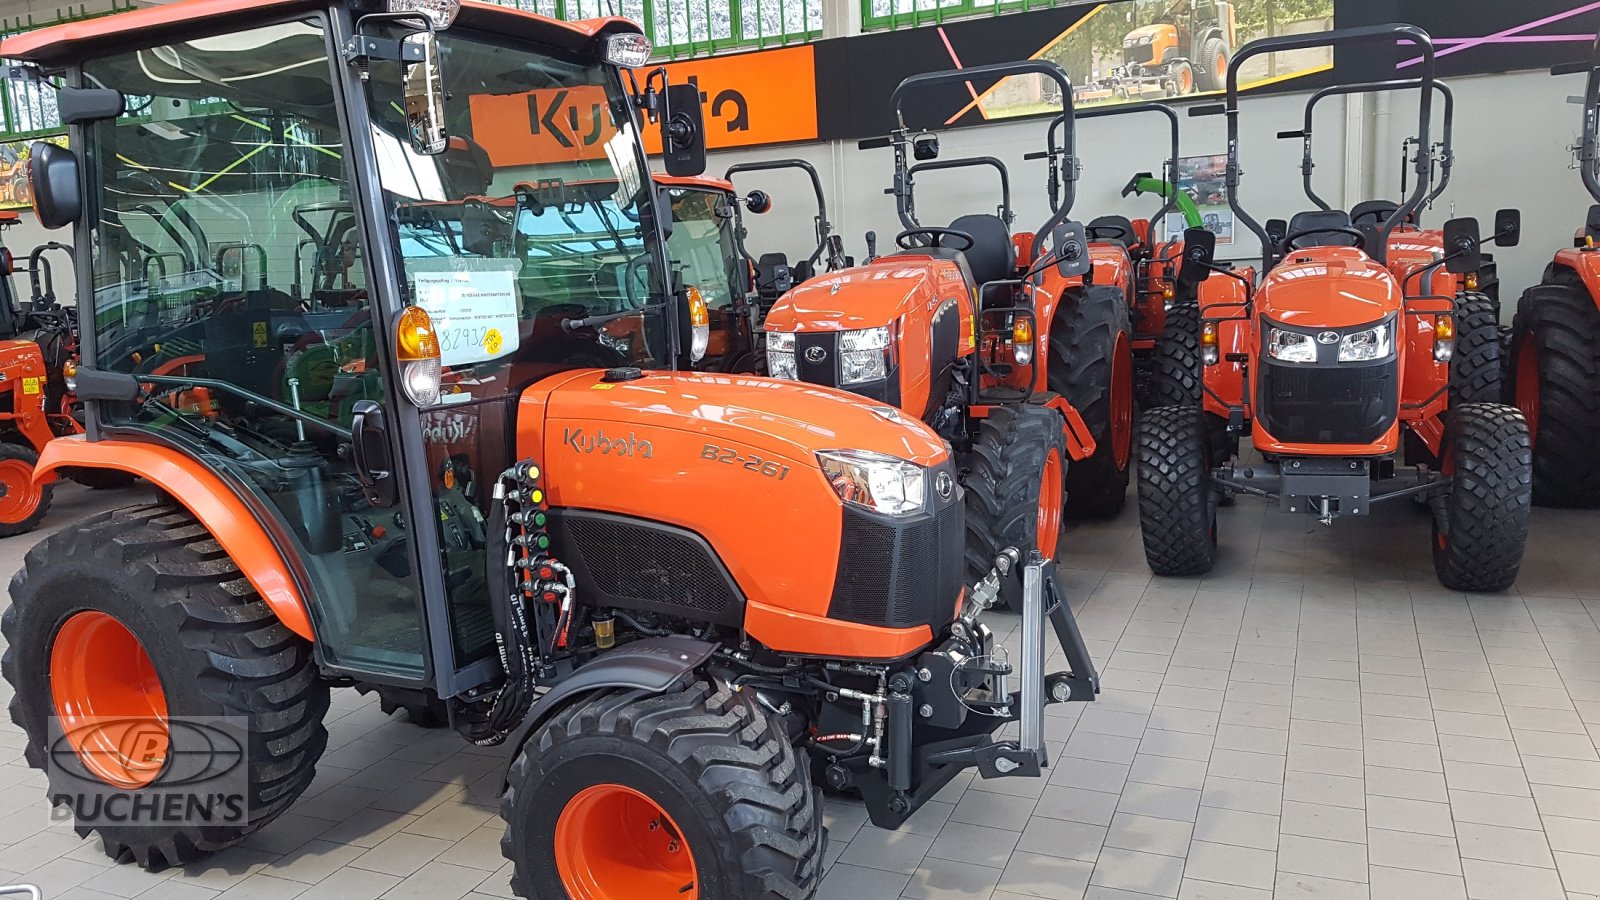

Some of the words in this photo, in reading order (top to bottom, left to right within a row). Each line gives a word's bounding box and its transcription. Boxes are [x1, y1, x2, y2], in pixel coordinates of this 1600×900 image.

[441, 325, 487, 352] 82932
[563, 427, 653, 459] Kubota
[700, 443, 790, 481] B2-261
